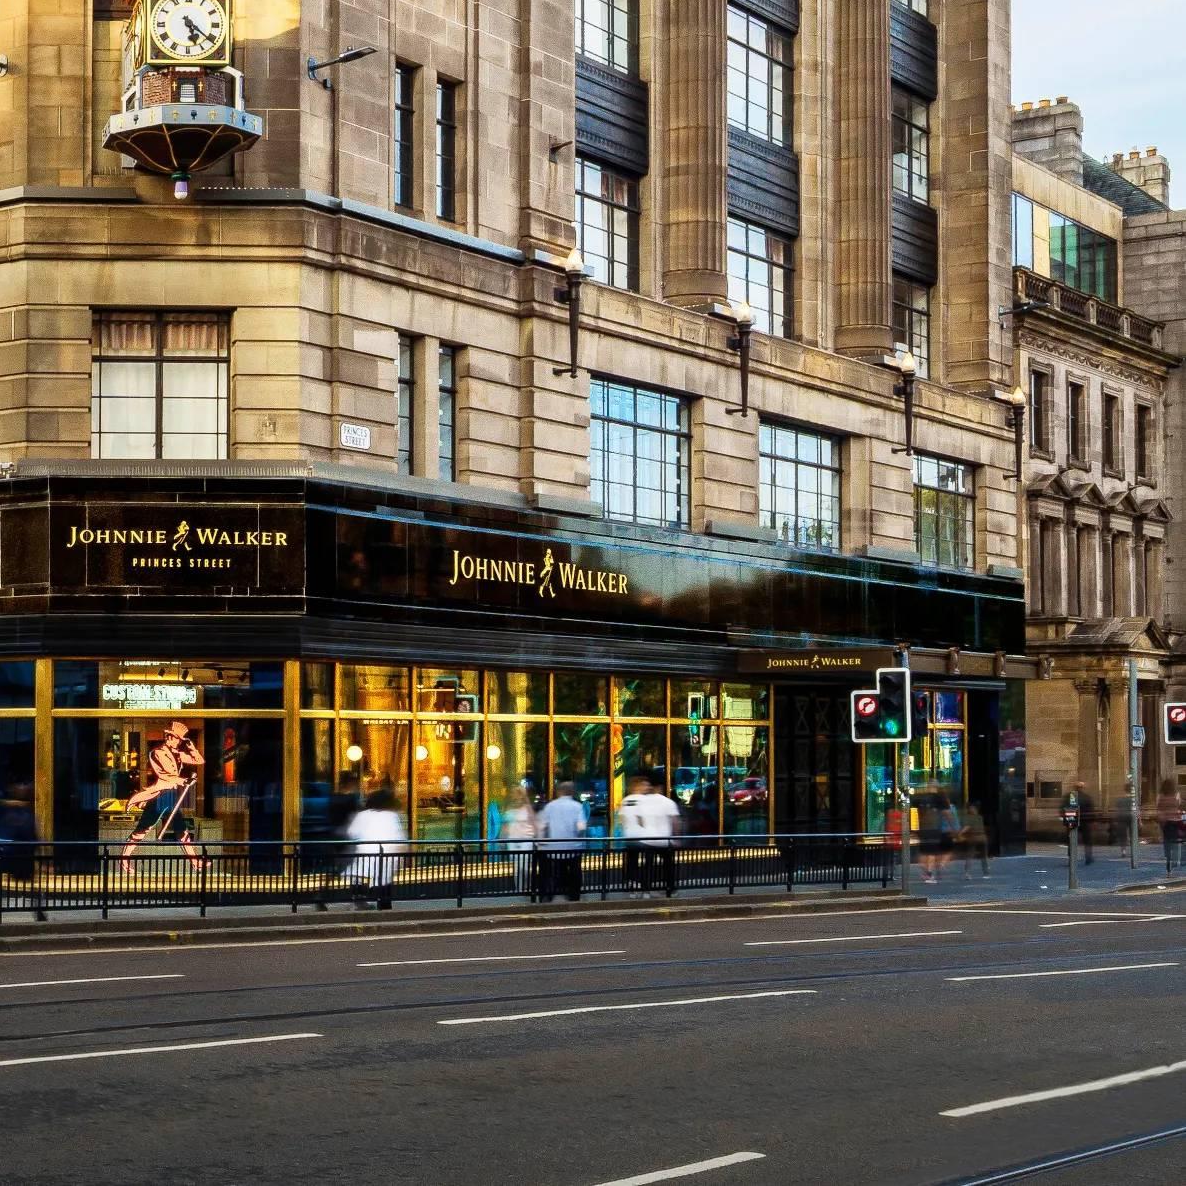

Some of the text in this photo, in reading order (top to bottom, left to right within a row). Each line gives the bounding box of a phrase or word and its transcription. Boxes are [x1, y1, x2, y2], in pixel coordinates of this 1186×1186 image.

[343, 425, 368, 438] PRINCES
[344, 435, 366, 447] STREET
[66, 526, 288, 548] JOHNNIE WALKER
[132, 557, 231, 569] PRINCES STREET
[449, 549, 629, 595] JOHNNIE WALKER
[766, 657, 861, 669] JOHNNIE WALKER
